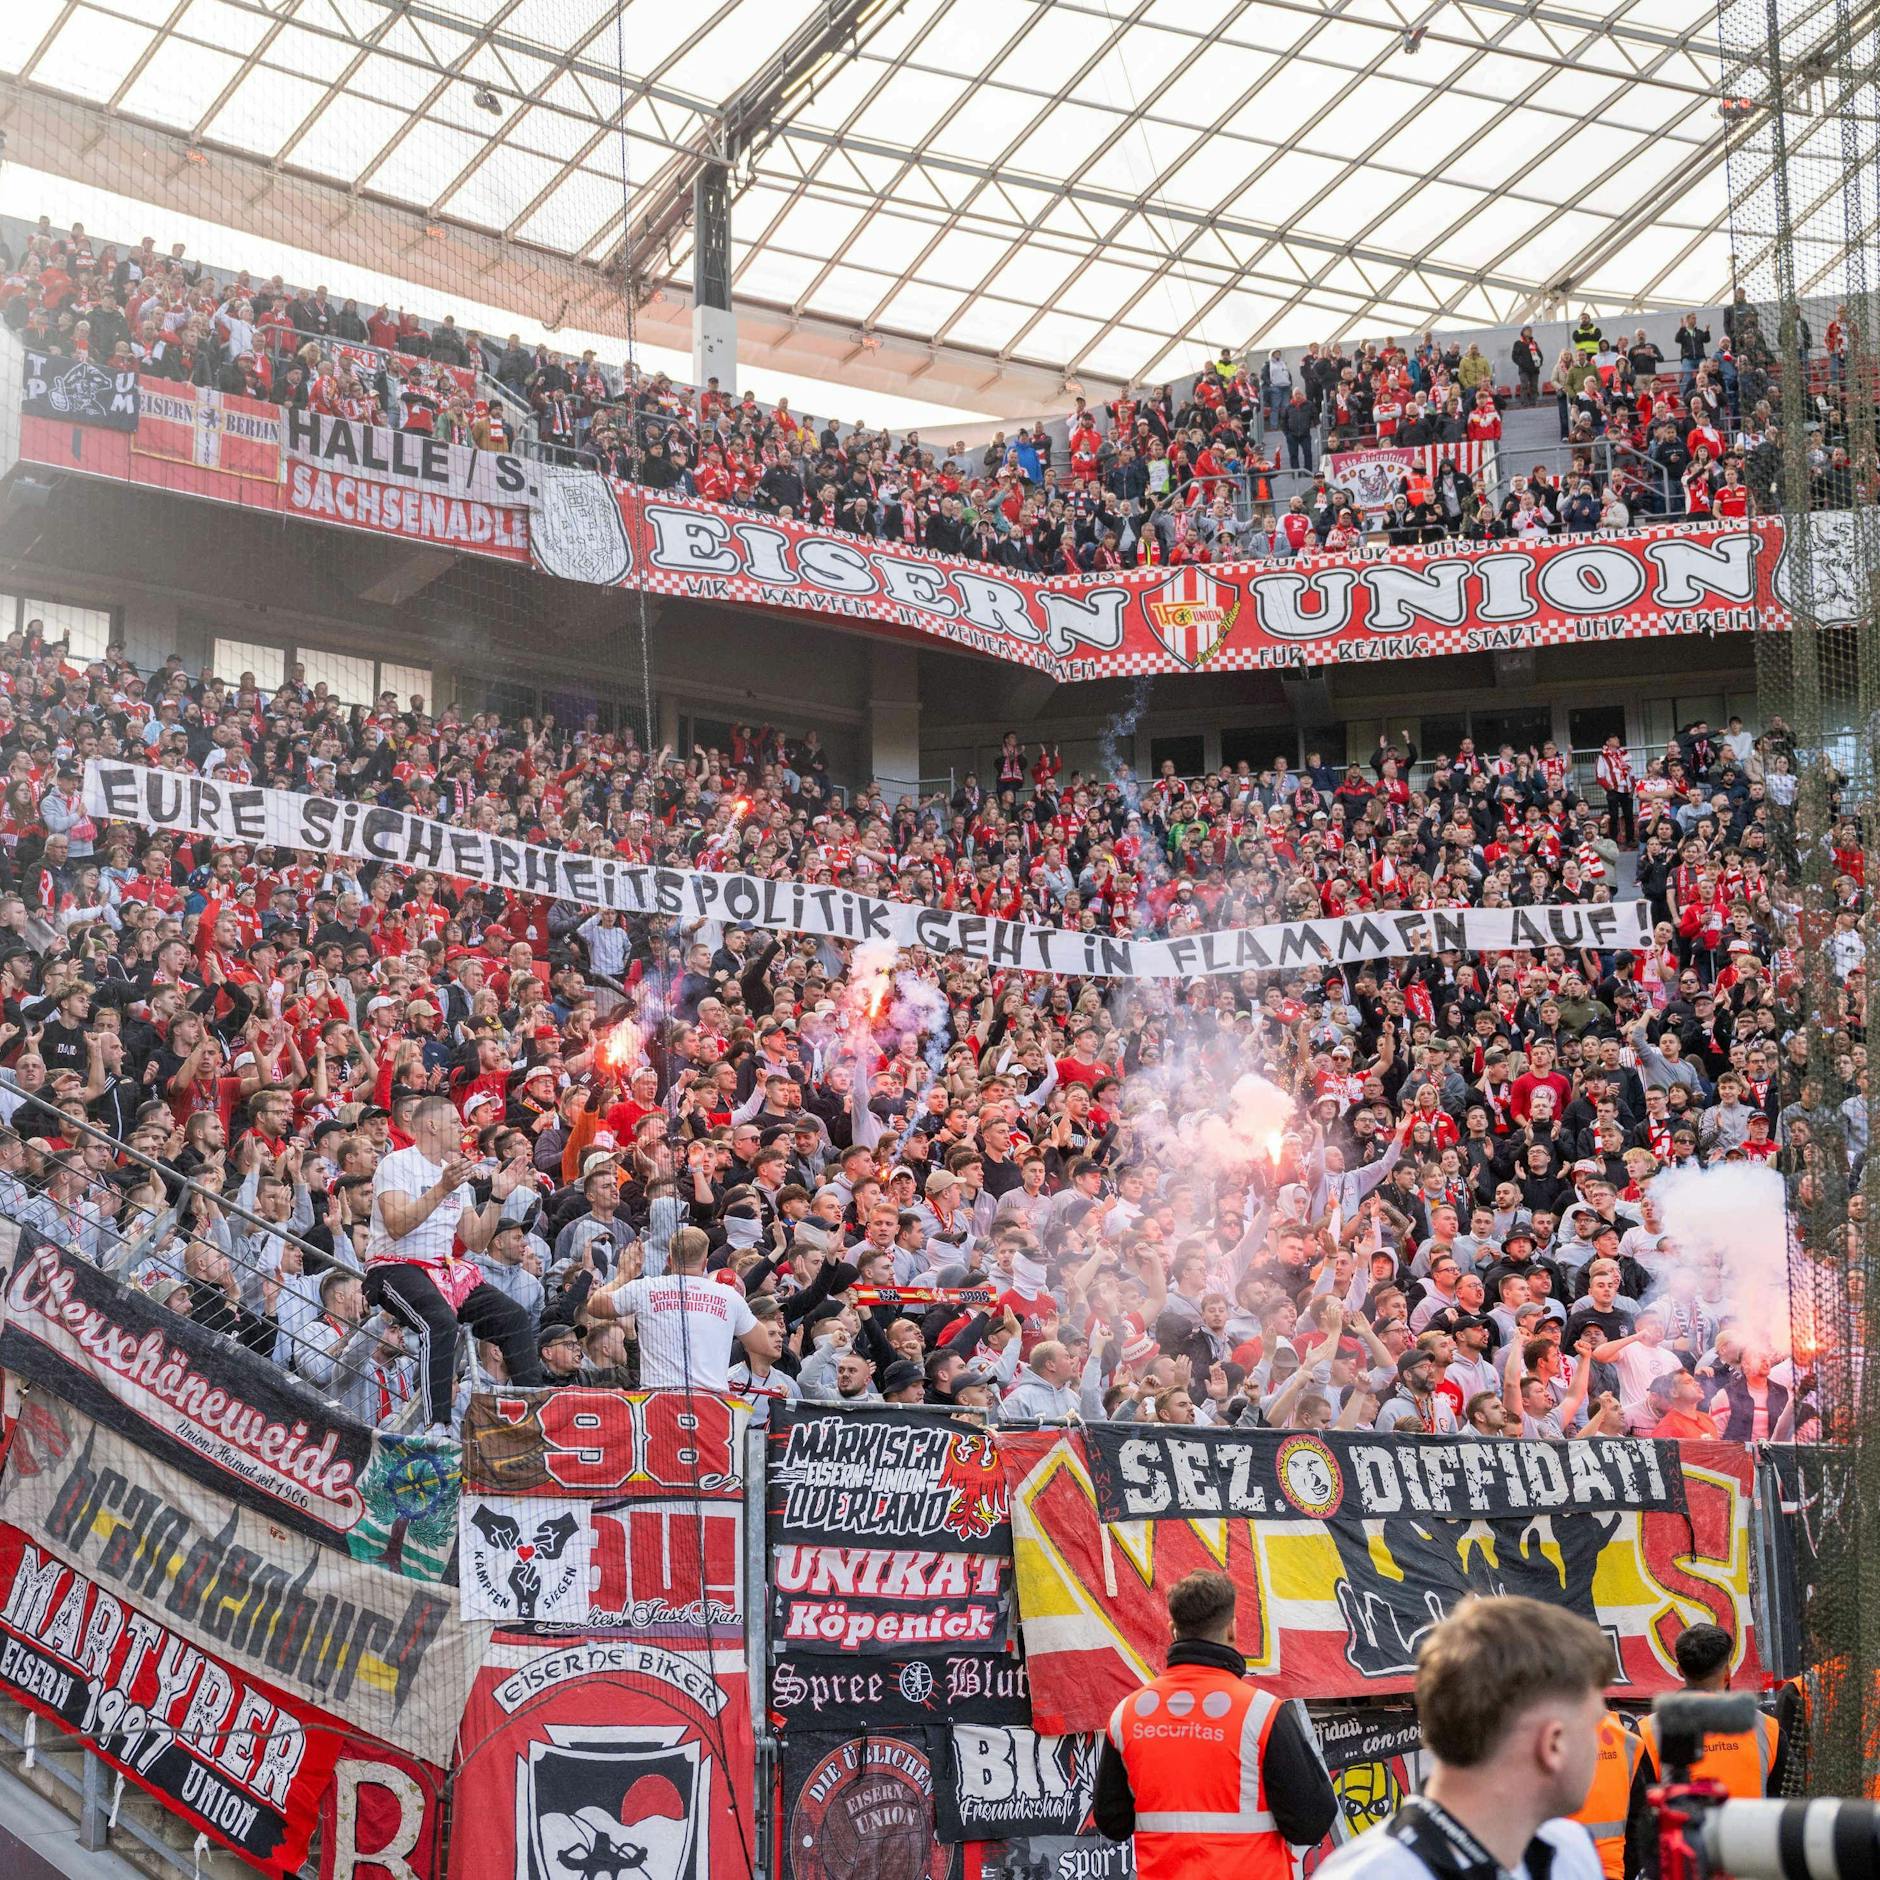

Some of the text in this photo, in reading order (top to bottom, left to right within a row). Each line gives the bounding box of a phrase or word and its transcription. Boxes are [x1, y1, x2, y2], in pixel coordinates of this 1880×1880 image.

[225, 414, 280, 441] BERLIN
[287, 406, 449, 484] HALLE
[291, 464, 530, 548] SACHSENADLE
[644, 504, 1764, 658] EISERN UNION
[685, 576, 730, 597] WIR
[1467, 624, 1541, 649] STADT
[1576, 617, 1625, 638] UND
[100, 768, 266, 839] EURE
[916, 908, 1057, 970] GEHT
[1166, 911, 1468, 974] FLAMMEN
[175, 1418, 309, 1509] Unions Heimat seit 1906
[1119, 1439, 1287, 1514] SEZ.
[1348, 1438, 1667, 1514] DIFFIDATI
[775, 1545, 1013, 1599] UNIKAT
[784, 1600, 995, 1649] Köpenick
[771, 1663, 884, 1711] Spree
[0, 1640, 259, 1844] EISERN 1997 UNION
[1132, 1721, 1225, 1742] Securitas
[1362, 1731, 1397, 1754] con
[808, 1761, 842, 1804] DIE
[847, 1783, 918, 1836] EISERN UNION
[958, 1789, 1075, 1826] Freundschaft
